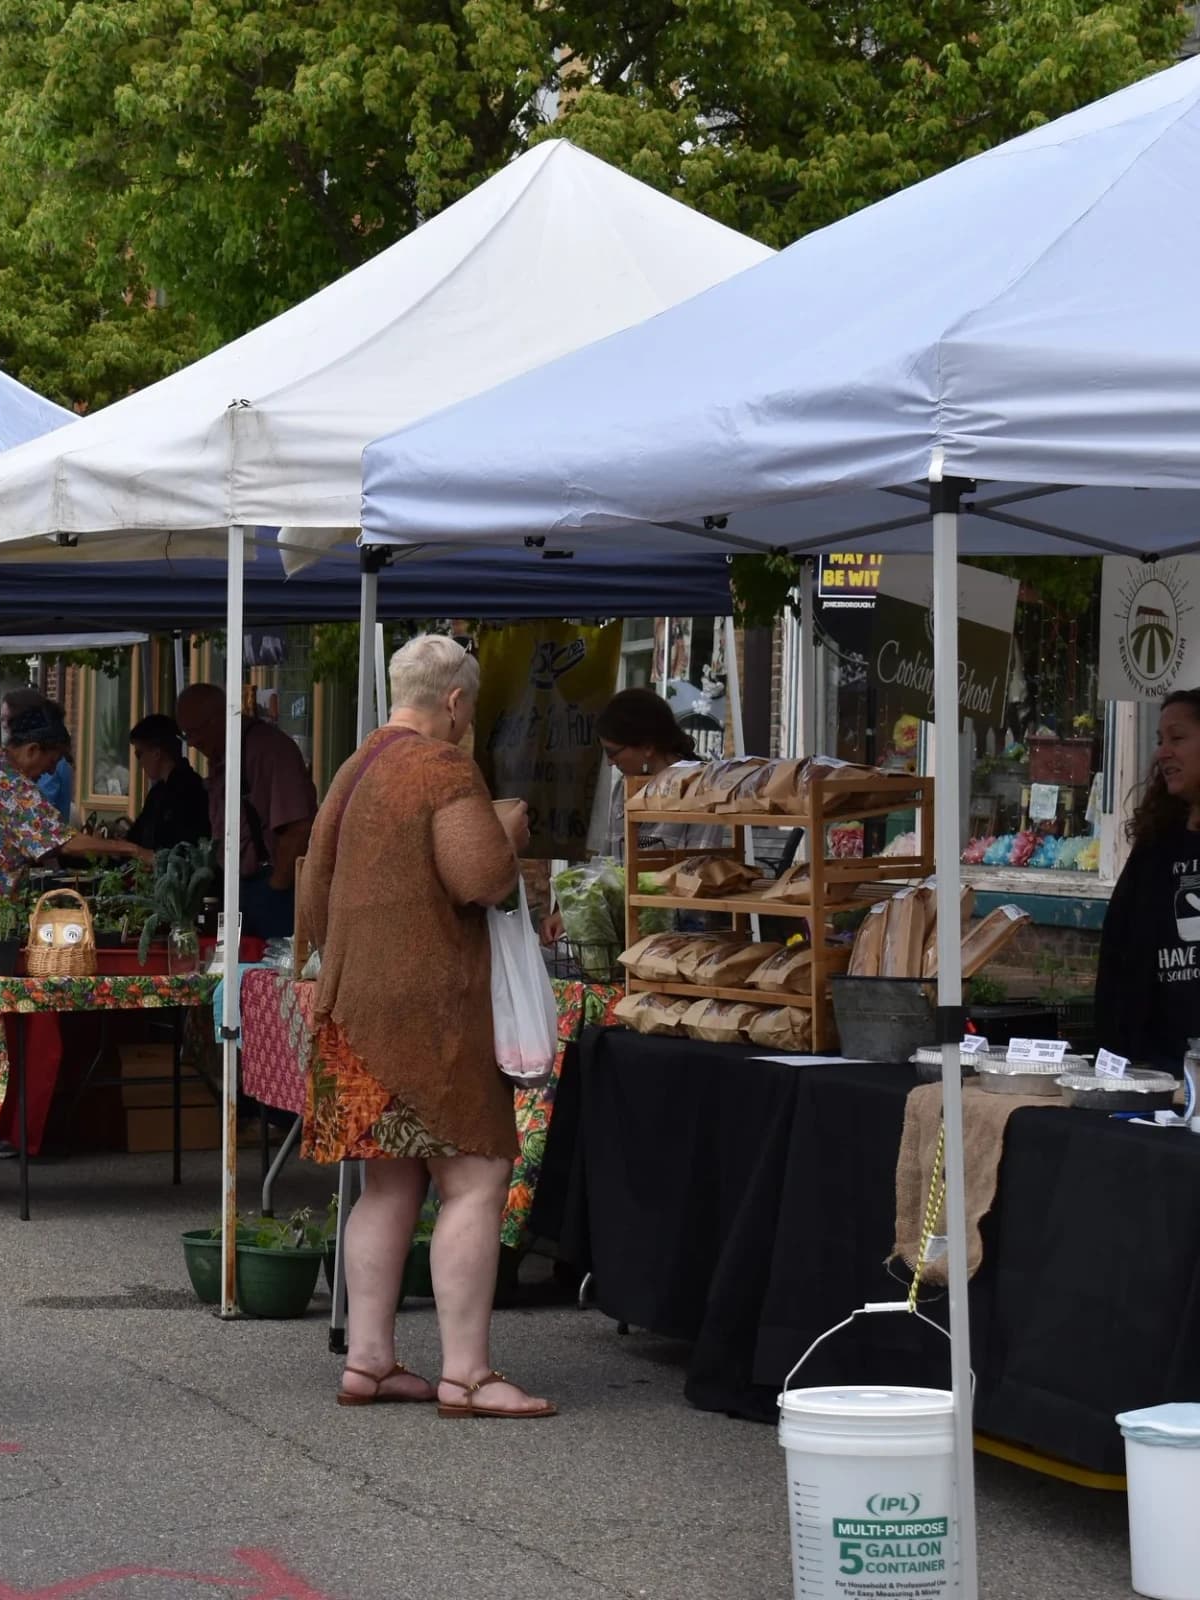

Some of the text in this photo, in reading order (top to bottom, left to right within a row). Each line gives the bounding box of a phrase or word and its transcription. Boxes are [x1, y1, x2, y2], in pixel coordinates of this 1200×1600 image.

[823, 569, 880, 587] BE WIT
[1119, 636, 1187, 697] SERENITY KNOLL FARM
[1159, 945, 1197, 968] HAVE
[838, 1522, 945, 1536] MULTI-PURPOSE
[839, 1541, 942, 1575] 5 GALLON
[865, 1560, 945, 1574] CONTAINER
[848, 1581, 887, 1589] Household
[896, 1580, 936, 1588] Professional
[844, 1588, 856, 1596] For
[857, 1590, 875, 1598] Easy
[876, 1590, 913, 1598] Measuring
